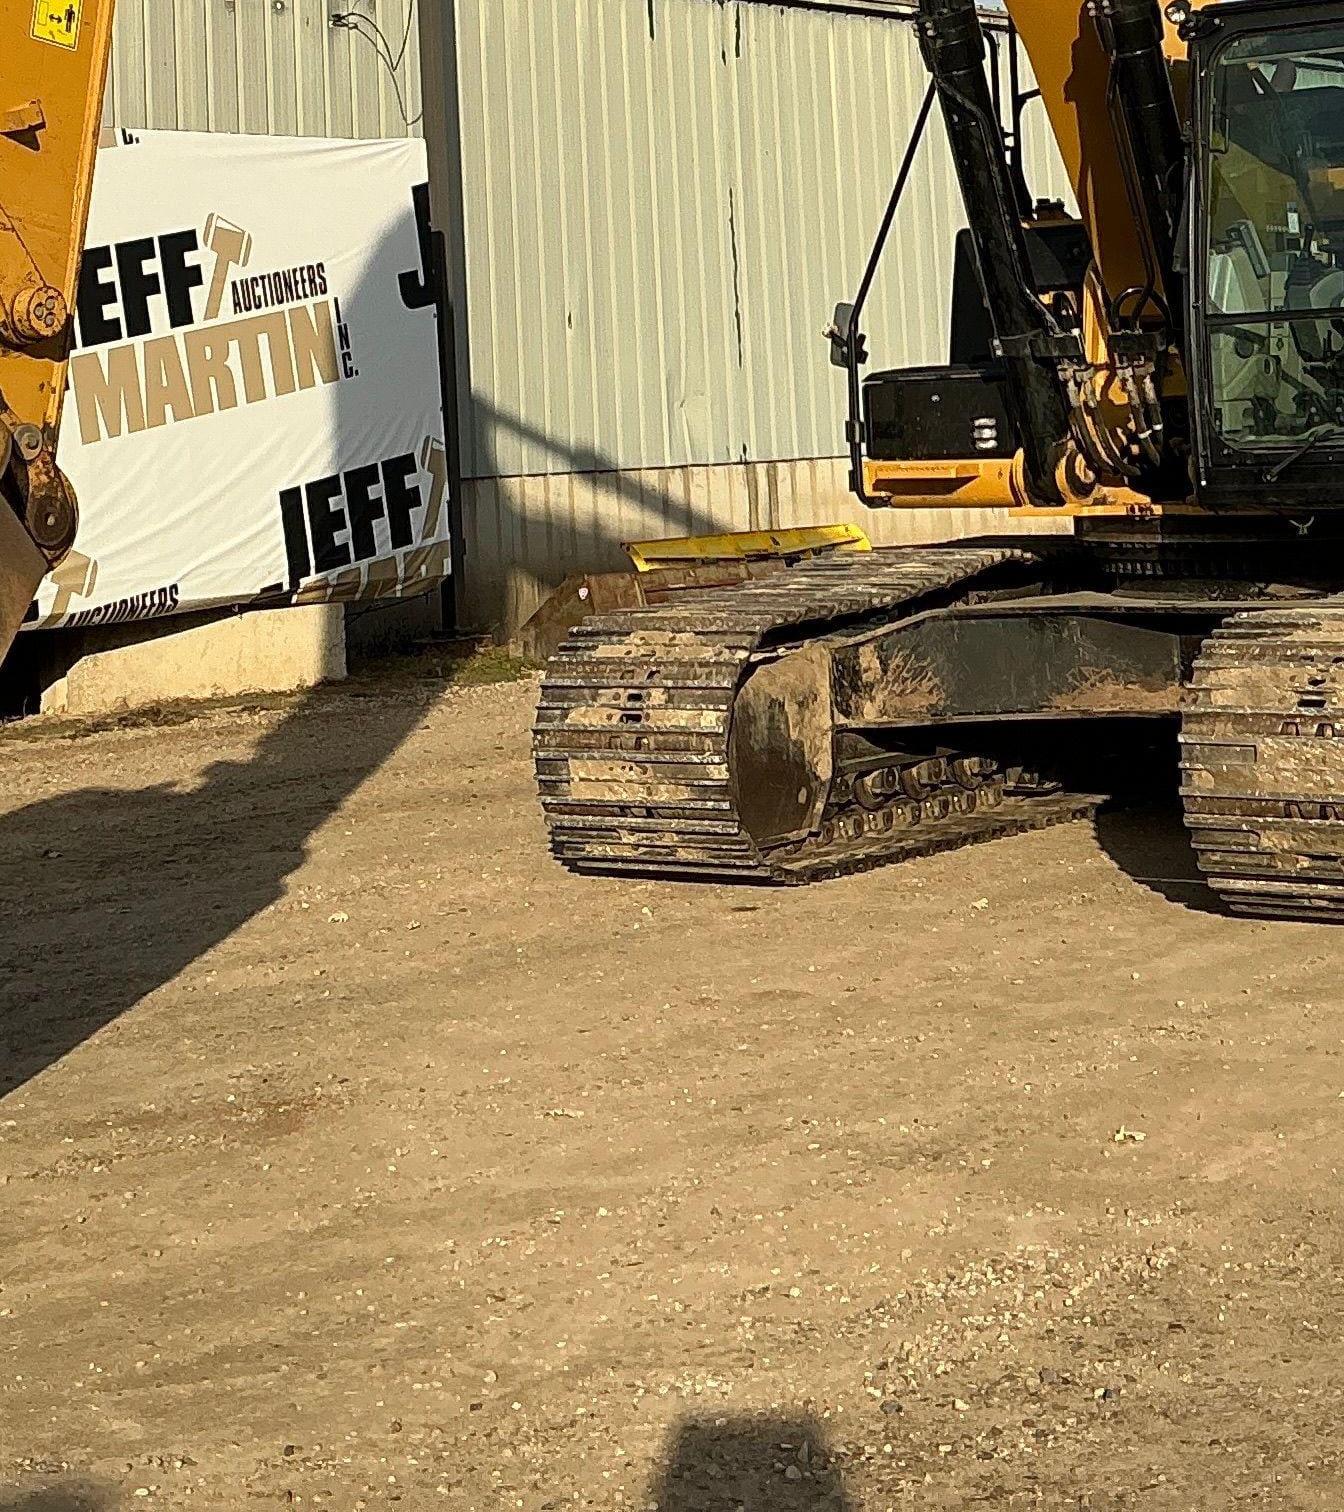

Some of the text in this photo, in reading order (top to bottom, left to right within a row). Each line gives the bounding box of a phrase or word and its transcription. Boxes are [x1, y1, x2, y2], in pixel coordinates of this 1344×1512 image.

[71, 229, 204, 348] EFF
[231, 262, 328, 314] AUCTIONEERS
[334, 296, 359, 380] INC.
[71, 300, 340, 445] MARTIN
